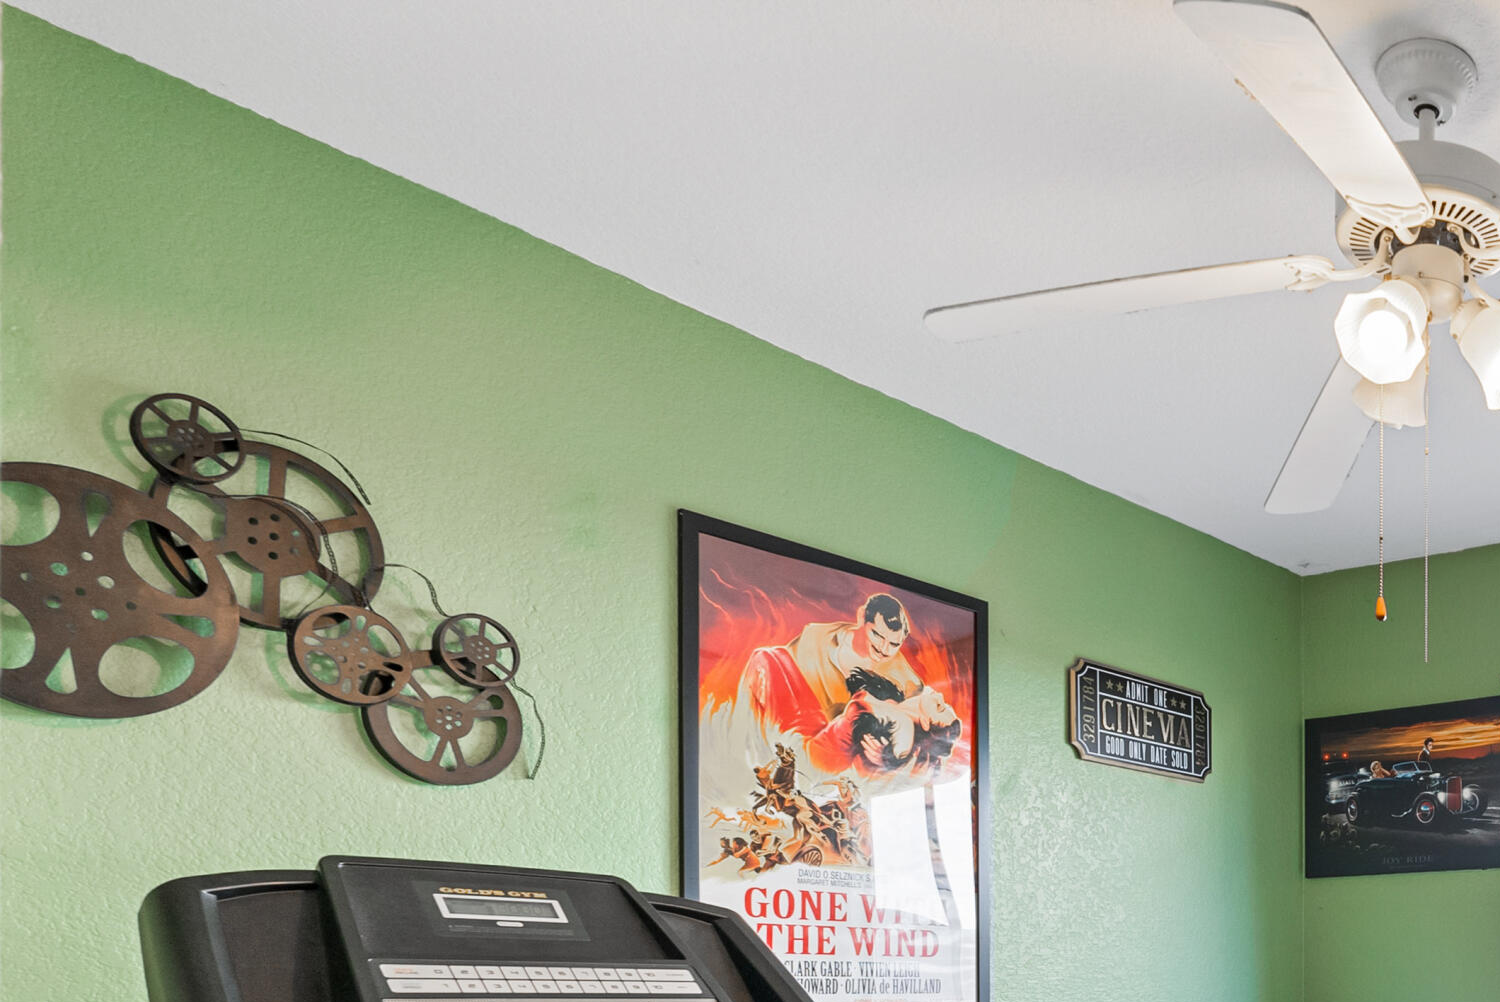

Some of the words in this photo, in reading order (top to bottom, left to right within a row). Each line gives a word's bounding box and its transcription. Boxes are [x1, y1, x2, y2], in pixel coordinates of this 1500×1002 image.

[1126, 681, 1149, 704] ADMIT
[1154, 688, 1168, 709] ONE
[1106, 735, 1126, 757] GOOD
[1129, 741, 1147, 761] ONLY
[1151, 746, 1168, 766] DATE
[1171, 750, 1189, 770] SOLD
[798, 868, 821, 879] DAVID
[744, 887, 848, 922] GONE
[756, 923, 836, 955] THE
[847, 926, 939, 957] WIND
[820, 960, 852, 977] GABLE
[858, 961, 891, 977] VIVIEN
[845, 978, 877, 995] OLIVIA
[879, 978, 890, 994] de
[892, 978, 942, 995] HAVILLAND
